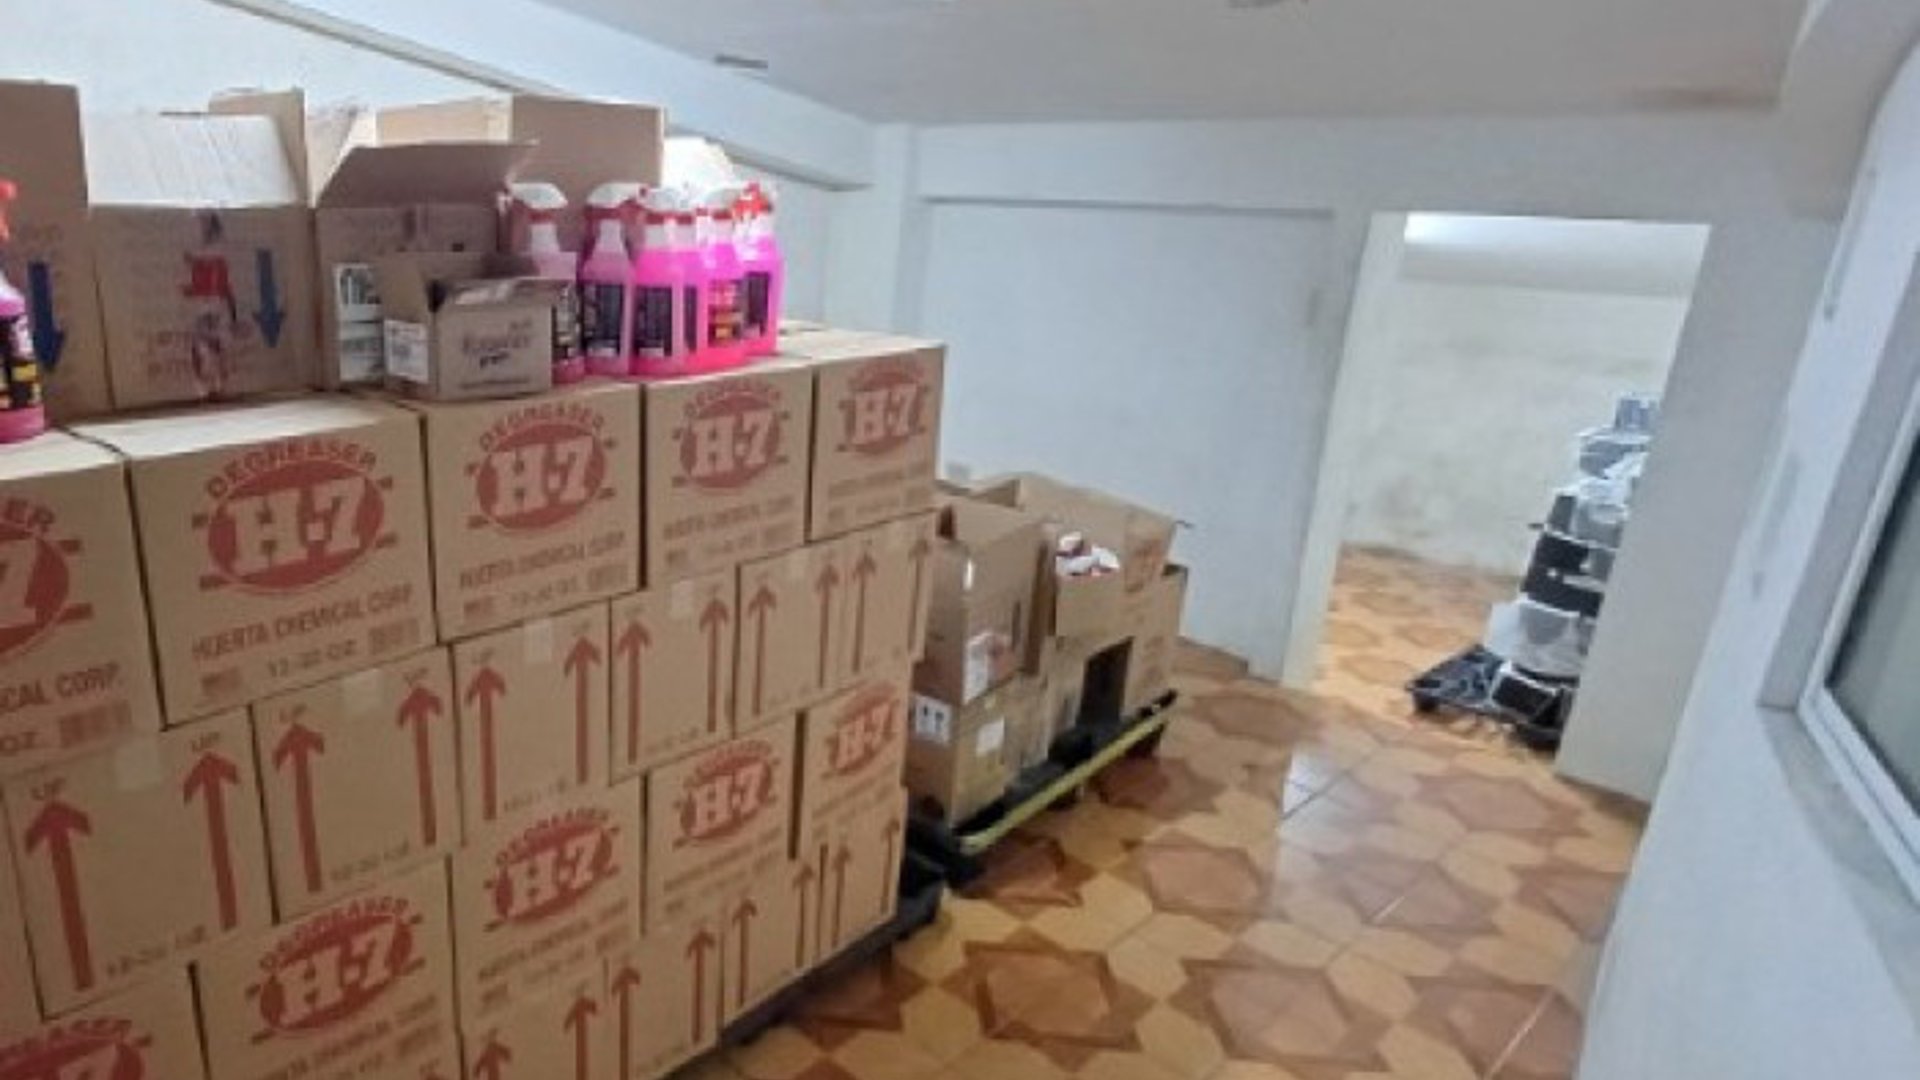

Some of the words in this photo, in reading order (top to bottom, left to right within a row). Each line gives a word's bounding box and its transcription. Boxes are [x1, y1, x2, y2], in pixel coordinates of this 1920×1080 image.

[480, 402, 605, 455] DEGREASER
[692, 410, 775, 478] H-7
[206, 436, 379, 501] DEGREASER
[489, 435, 594, 517] H-7
[226, 477, 366, 577] H-7
[274, 597, 367, 639] CHEMICAL
